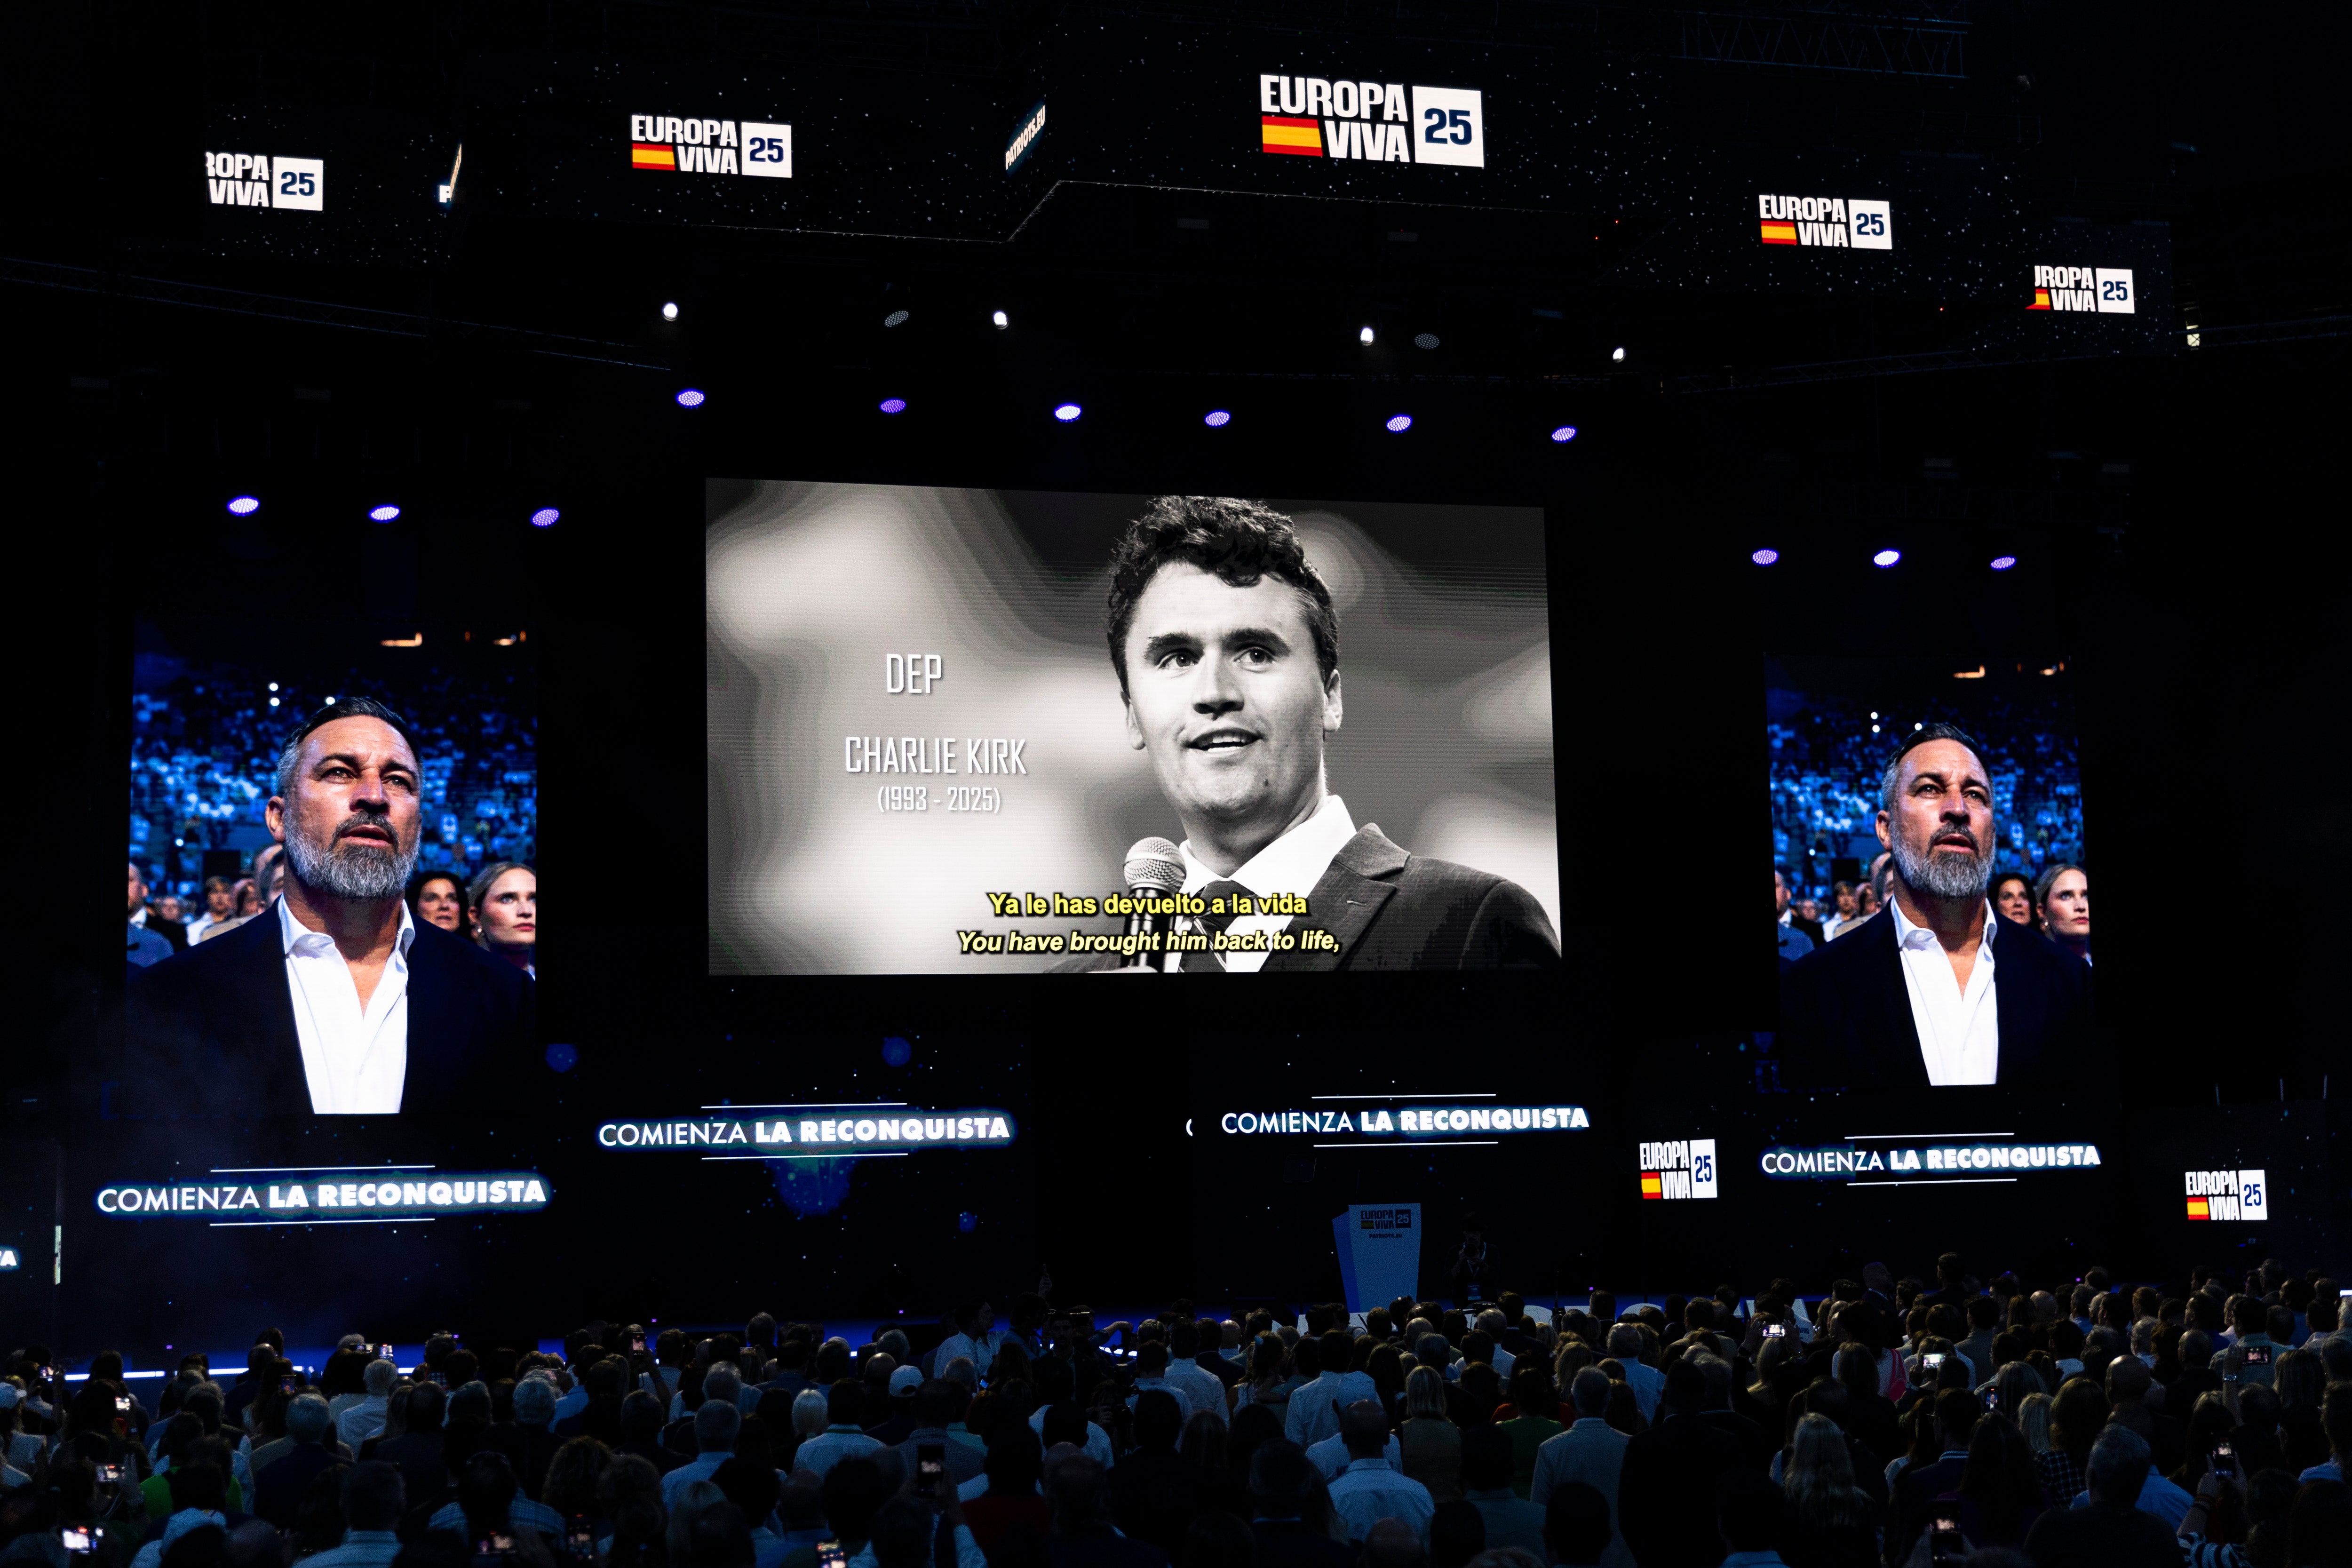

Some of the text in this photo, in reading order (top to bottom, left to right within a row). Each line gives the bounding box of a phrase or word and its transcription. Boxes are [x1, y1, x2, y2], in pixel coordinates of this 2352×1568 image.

[1260, 74, 1408, 122] EUROPA
[631, 115, 738, 147] EUROPA
[1005, 105, 1045, 170] PATRIOTS.EU
[1424, 108, 1472, 145] 25
[749, 137, 784, 163] 25
[1324, 120, 1410, 163] VIVA
[677, 145, 738, 175] VIVA
[208, 179, 269, 207] VIVA
[281, 171, 315, 196] 25
[1759, 194, 1847, 223] EUROPA
[1797, 222, 1849, 247] VIVA
[1856, 213, 1884, 236] 25
[2050, 289, 2096, 312] VIVA
[2102, 280, 2128, 301] 25
[886, 653, 941, 693] DEP
[846, 736, 1027, 774] CHARLIE KIRK
[878, 786, 927, 812] (1993
[947, 787, 1001, 813] 2025)
[989, 892, 1307, 914] Ya le has devuelto a la vida
[959, 930, 1339, 955] You have brought him back to life,
[599, 1116, 1010, 1146] COMIENZA LA RECONQUISTA
[1222, 1108, 1589, 1134] COMIENZA LA RECONQUISTA
[1639, 1140, 1690, 1170] EUROPA
[1762, 1146, 2101, 1173] COMIENZA LA RECONQUISTA
[1695, 1155, 1712, 1183] 25
[2185, 1170, 2239, 1195] EUROPA
[98, 1180, 546, 1212] COMIENZA LA RECONQUISTA
[1661, 1170, 1691, 1199] VIVA
[2244, 1184, 2262, 1206] 25
[1360, 1210, 1394, 1219] EUROPA
[1397, 1214, 1409, 1223] 25
[2208, 1196, 2241, 1220] VIVA
[1375, 1219, 1394, 1229] VIVA
